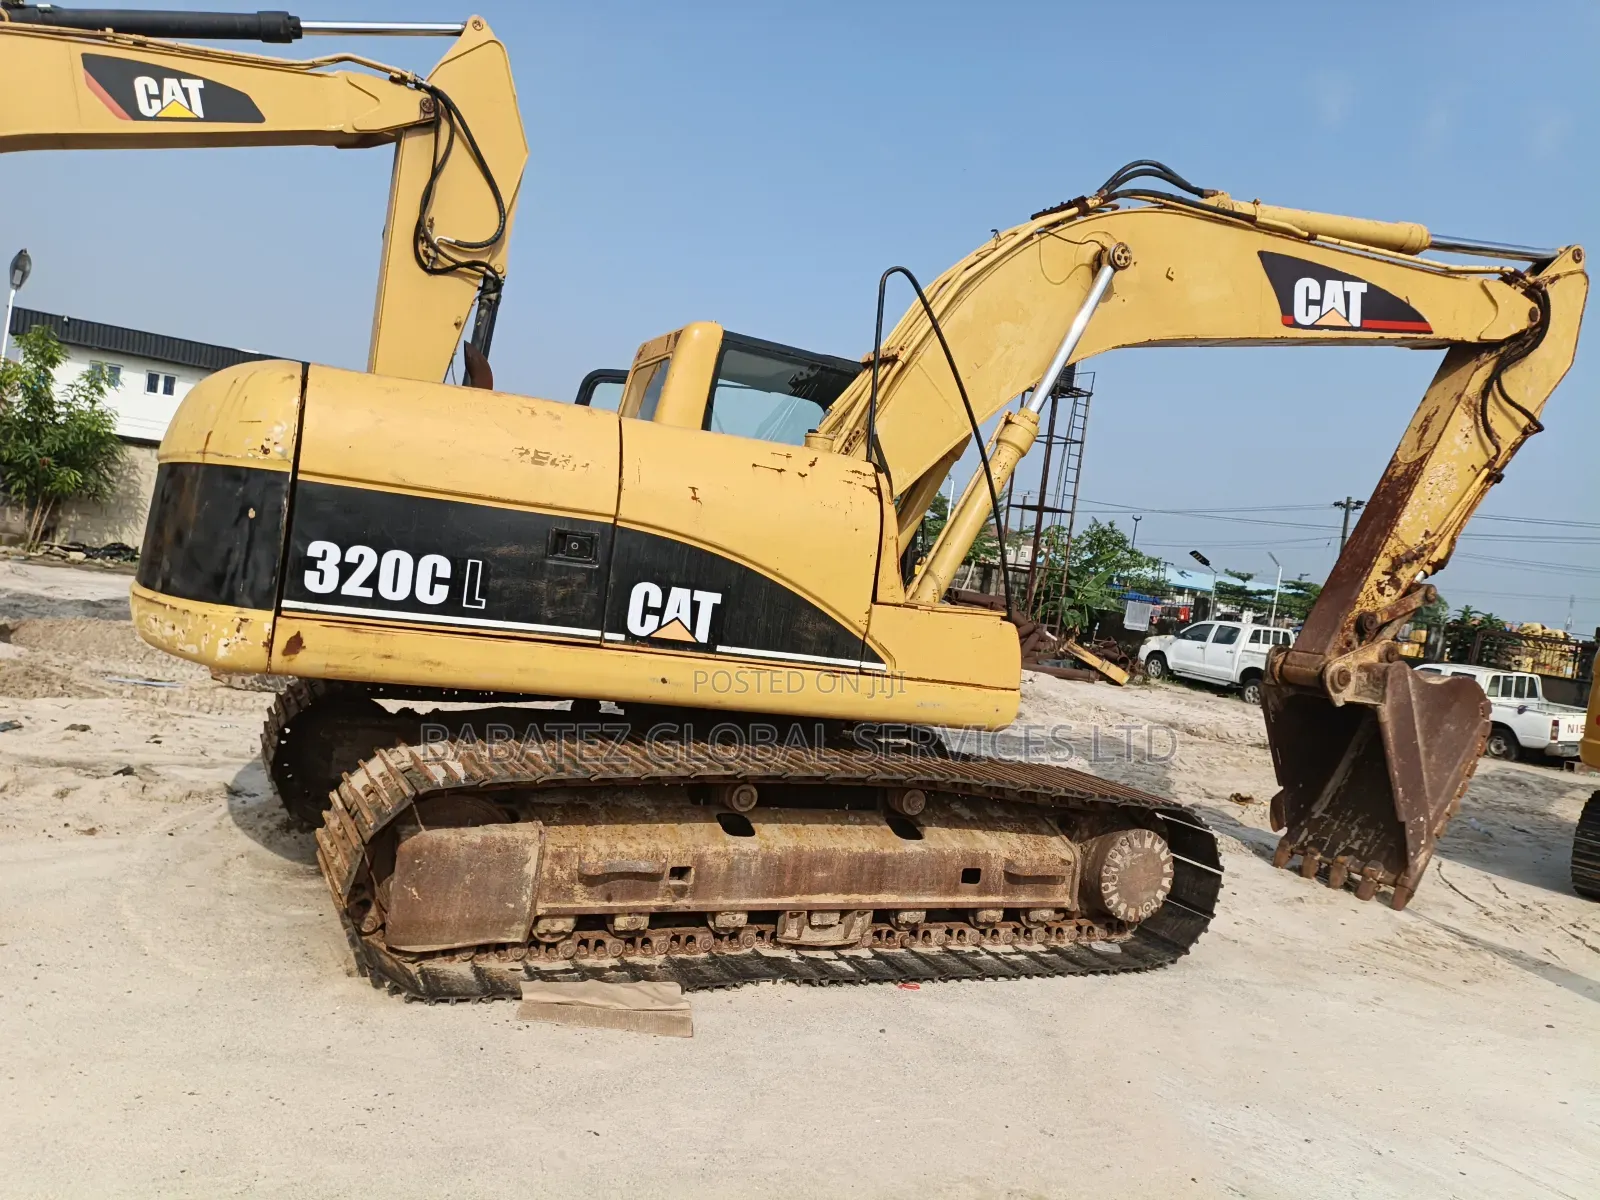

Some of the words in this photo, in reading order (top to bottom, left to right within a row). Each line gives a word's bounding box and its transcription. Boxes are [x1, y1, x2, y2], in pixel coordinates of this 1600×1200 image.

[134, 76, 204, 118] CAT
[1294, 277, 1367, 327] CAT
[303, 540, 452, 605] 320C
[462, 559, 486, 609] L
[626, 582, 722, 643] CAT
